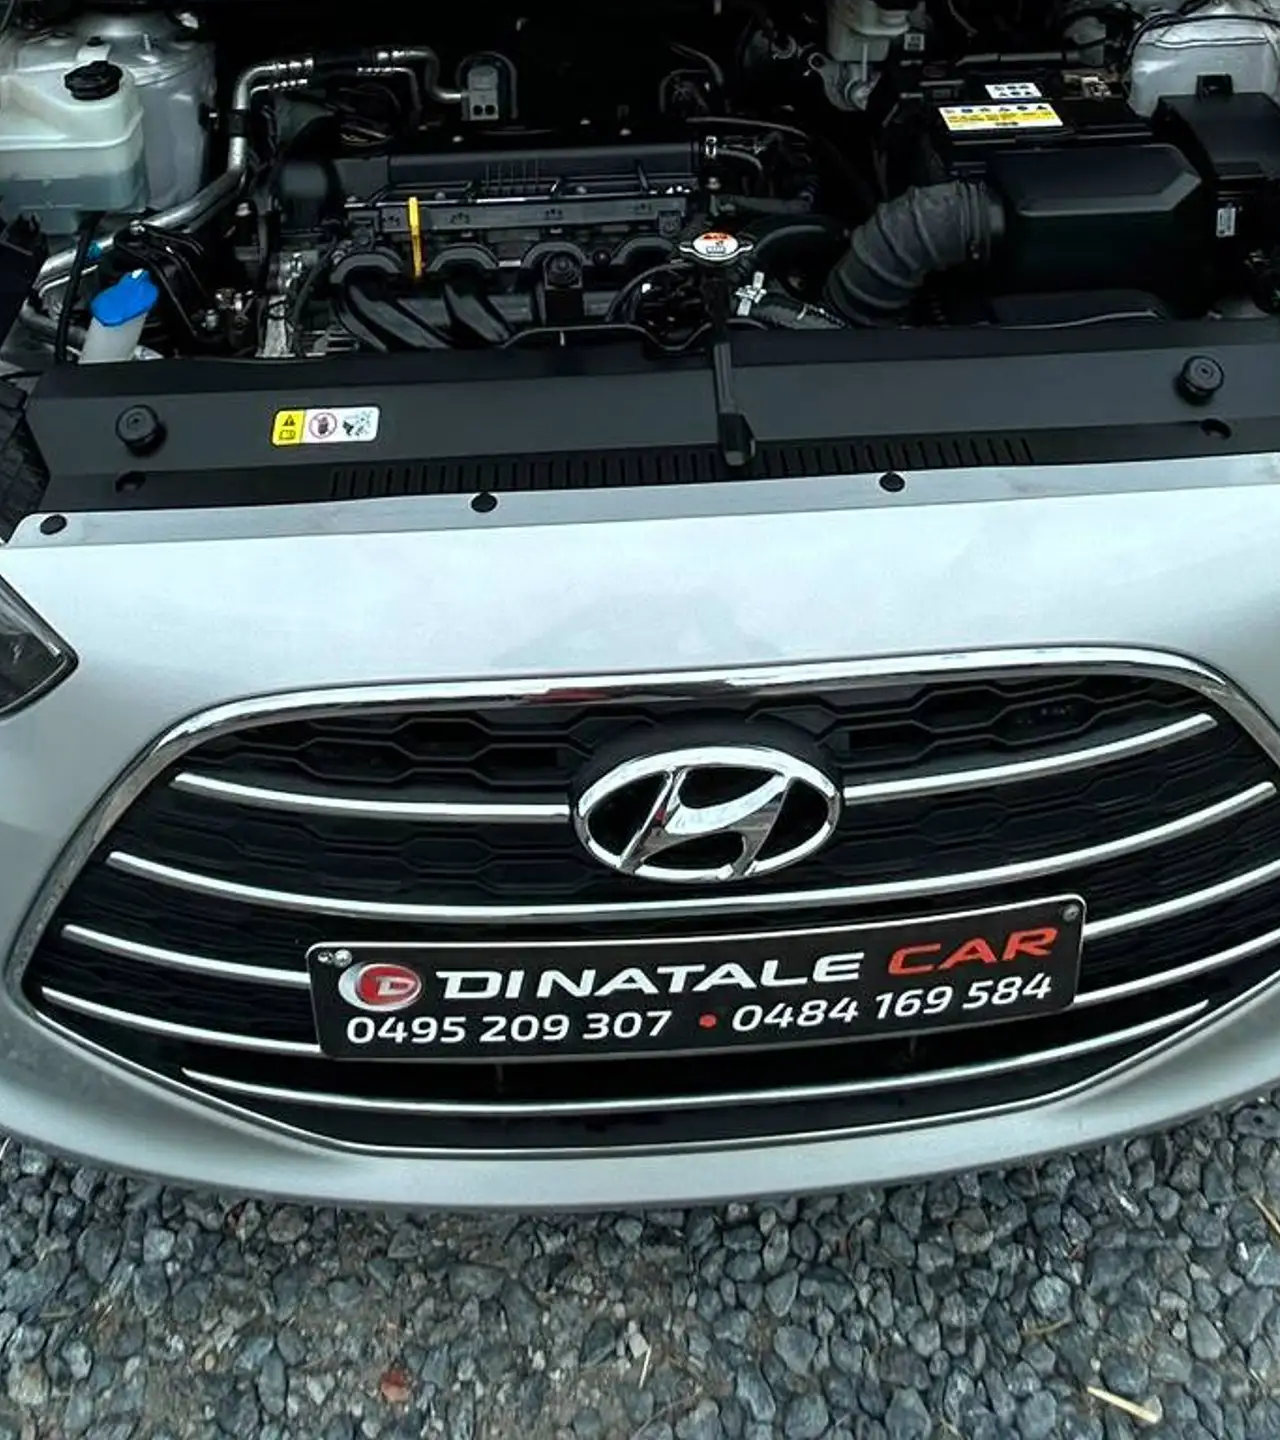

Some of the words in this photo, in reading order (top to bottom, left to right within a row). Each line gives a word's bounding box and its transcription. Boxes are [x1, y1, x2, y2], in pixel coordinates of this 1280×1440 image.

[888, 927, 1059, 975] CAR
[346, 1015, 467, 1044] 0495
[478, 1014, 570, 1043] 209
[582, 1010, 673, 1040] 307
[732, 997, 859, 1032] 0484
[875, 985, 954, 1020] 169
[962, 971, 1052, 1010] 584
